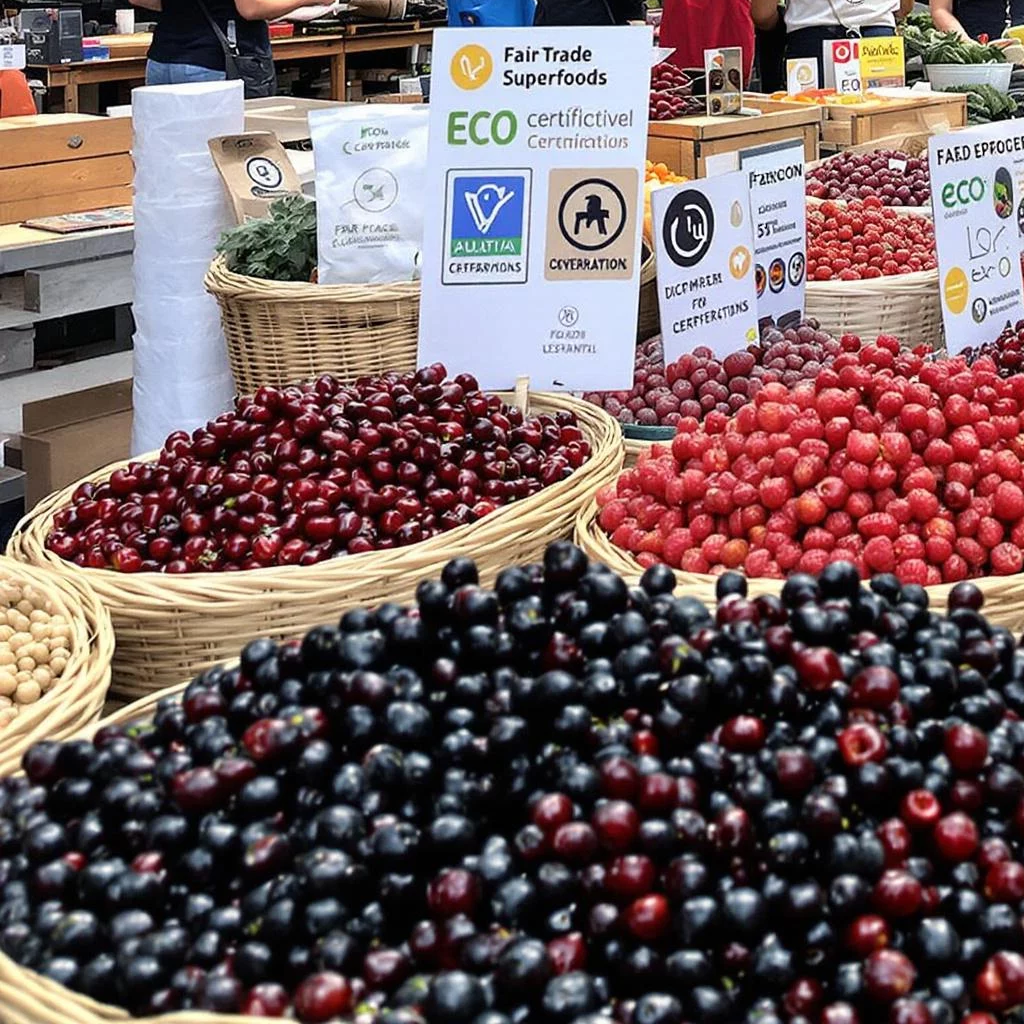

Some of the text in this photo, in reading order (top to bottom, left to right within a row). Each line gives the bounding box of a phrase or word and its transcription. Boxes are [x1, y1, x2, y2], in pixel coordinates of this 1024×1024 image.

[504, 45, 592, 63] Fair Trade
[503, 68, 607, 89] Superfoods
[446, 109, 518, 146] ECO
